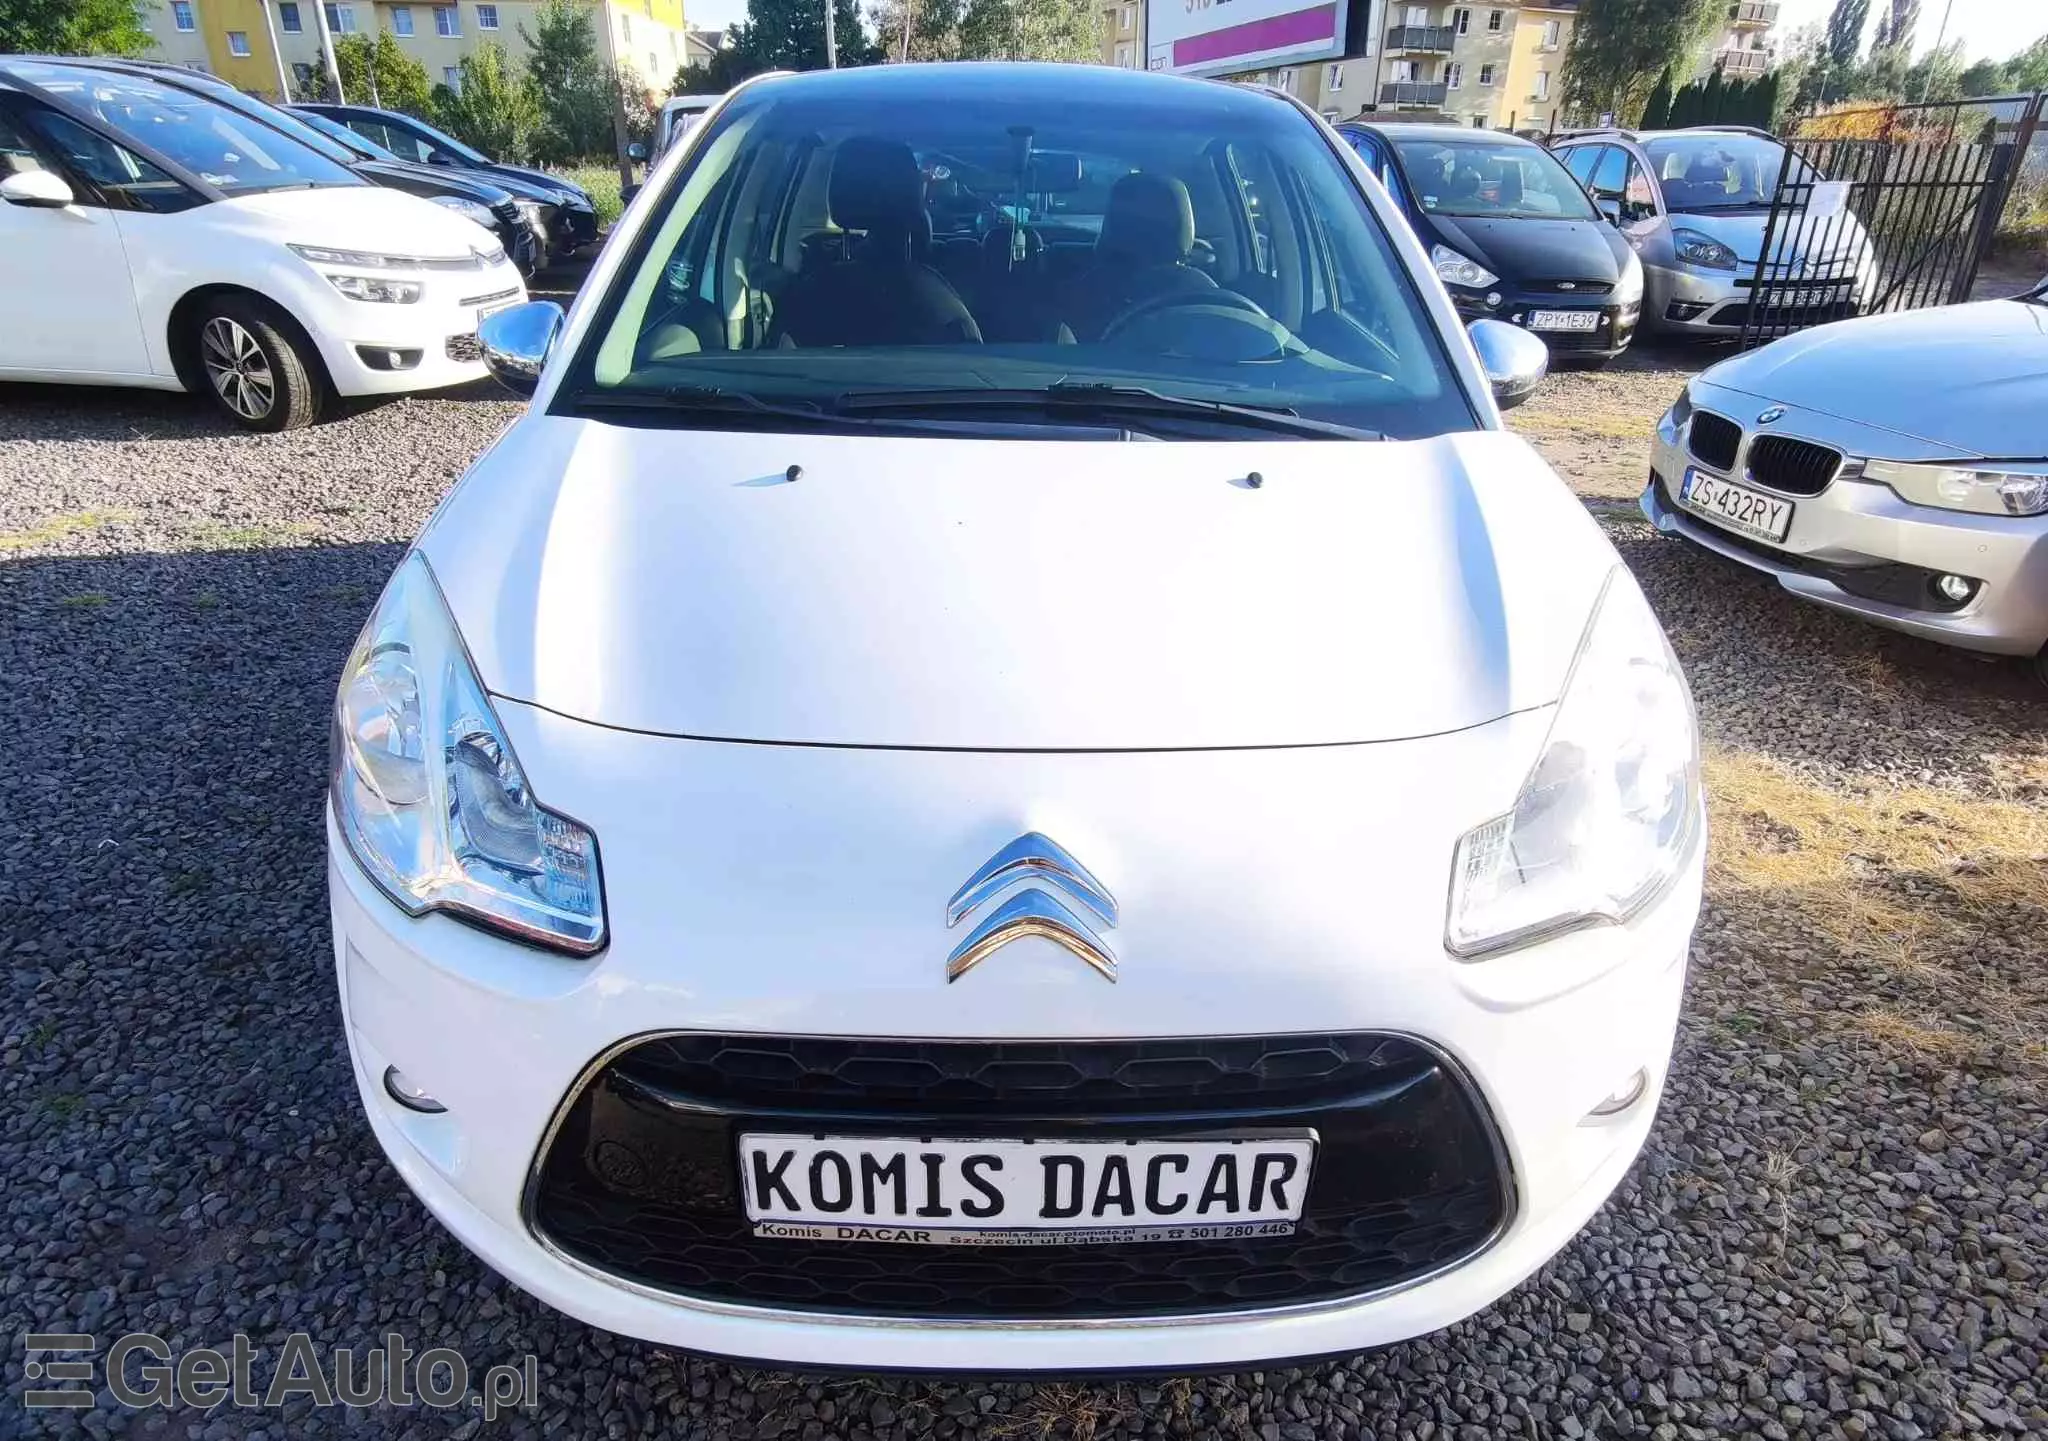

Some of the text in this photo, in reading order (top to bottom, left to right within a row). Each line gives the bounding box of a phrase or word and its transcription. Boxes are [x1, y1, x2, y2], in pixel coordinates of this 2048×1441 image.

[1691, 475, 1714, 505] ZS
[1718, 488, 1783, 530] 432RY
[752, 1149, 1298, 1218] KOMIS DACAR
[762, 1224, 931, 1242] Komis DACAR
[950, 1235, 1034, 1245] Szczecin
[1141, 1233, 1161, 1241] 19
[1190, 1223, 1288, 1239] 501 280 446
